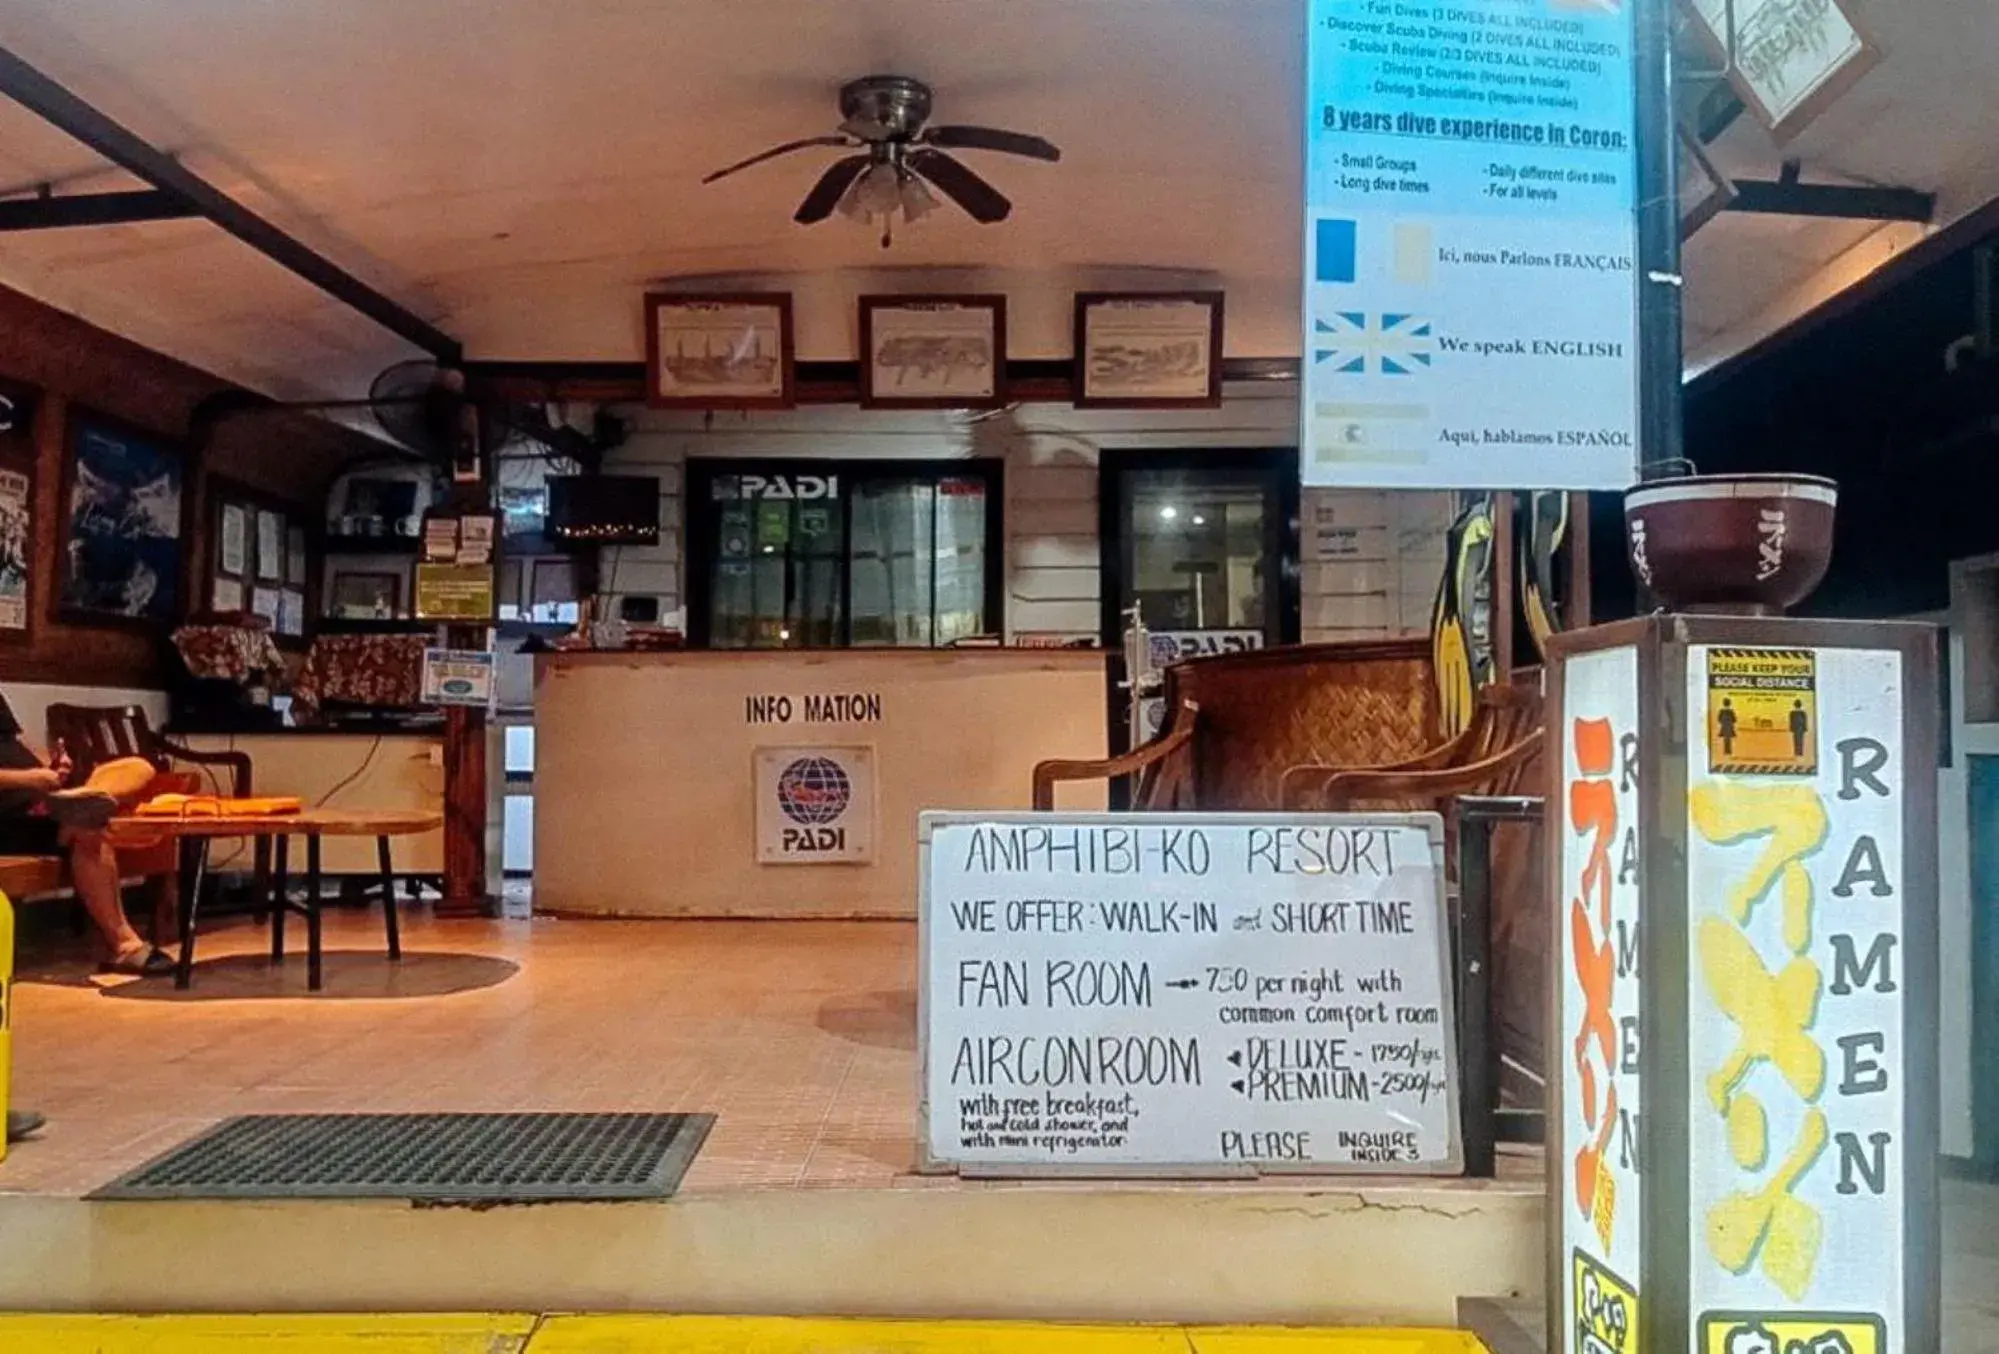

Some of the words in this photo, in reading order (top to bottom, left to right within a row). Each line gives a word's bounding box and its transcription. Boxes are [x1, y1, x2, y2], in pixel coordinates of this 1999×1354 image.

[1368, 1, 1391, 15] Fun
[1395, 4, 1428, 18] Dives
[1447, 9, 1485, 24] DIVES
[1488, 13, 1513, 27] ALL
[1515, 16, 1584, 35] INCLUDED)
[1328, 16, 1383, 33] Discover
[1386, 22, 1425, 38] Scuba
[1428, 26, 1467, 44] Diving
[1486, 31, 1523, 48] DIVES
[1526, 35, 1550, 50] ALL
[1553, 38, 1621, 58] INCLUDED)
[1348, 38, 1388, 53] Scuba
[1392, 41, 1436, 58] Review
[1464, 49, 1502, 64] DIVES
[1505, 52, 1530, 67] ALL
[1533, 55, 1601, 76] INCLUDED)
[1382, 61, 1422, 78] Diving
[1425, 65, 1476, 81] Courses
[1374, 80, 1415, 98] Diving
[1323, 105, 1335, 128] 8
[1339, 109, 1392, 131] years
[1397, 111, 1436, 134] dive
[1441, 116, 1543, 143] experience
[1570, 124, 1628, 149] Coron:
[1342, 153, 1373, 169] Small
[1376, 155, 1417, 174] Groups
[1489, 162, 1516, 181] Daily
[1519, 165, 1564, 181] different
[1566, 169, 1589, 183] dive
[1591, 171, 1617, 185] sites
[1341, 174, 1369, 193] Long
[1373, 176, 1396, 191] dive
[1399, 179, 1430, 193] times
[1489, 183, 1508, 197] For
[1510, 185, 1524, 198] all
[1527, 186, 1558, 200] levels
[1439, 247, 1460, 264] Ici,
[1463, 251, 1497, 264] nous
[1501, 250, 1550, 266] Parlons
[1554, 253, 1632, 271] FRANÇAIS
[1439, 336, 1469, 351] We
[1473, 339, 1526, 356] speak
[1532, 340, 1623, 358] ENGLISH
[1483, 428, 1553, 444] hablamos
[1557, 430, 1632, 447] ESPAÑOL
[741, 475, 838, 499] PADI
[1712, 662, 1750, 672] PLEASE
[1752, 663, 1778, 673] KEEP
[1714, 677, 1752, 686] SOCIAL
[1756, 678, 1809, 688] DISTANCE
[745, 696, 792, 723] INFO
[804, 694, 880, 722] MATION
[782, 827, 845, 851] PADI
[965, 827, 1210, 876] AMPHIBI-KO
[1248, 828, 1400, 877] RESORT
[950, 900, 997, 933] WE
[1100, 901, 1218, 933] WALK-IN
[1356, 901, 1415, 934] TIME
[1829, 737, 1898, 1197] RAMEN
[958, 960, 1028, 1008] FAN
[1047, 960, 1152, 1008] ROOM
[1256, 976, 1284, 1002] per
[1291, 968, 1344, 1002] night
[1357, 967, 1402, 993] with
[1219, 1006, 1296, 1024] common
[1306, 1001, 1389, 1032] comfort
[1396, 1006, 1439, 1024] room
[1248, 1038, 1350, 1070] DELUXE
[960, 1092, 999, 1116] with
[1003, 1099, 1040, 1124] free
[1046, 1090, 1139, 1120] breakfast,
[961, 1117, 984, 1131] hot
[1010, 1118, 1040, 1131] cold
[1044, 1117, 1098, 1134] shower,
[1101, 1116, 1129, 1133] and
[960, 1132, 995, 1148] with
[1221, 1131, 1313, 1161] PLEASE
[1338, 1130, 1418, 1148] INQUIRE
